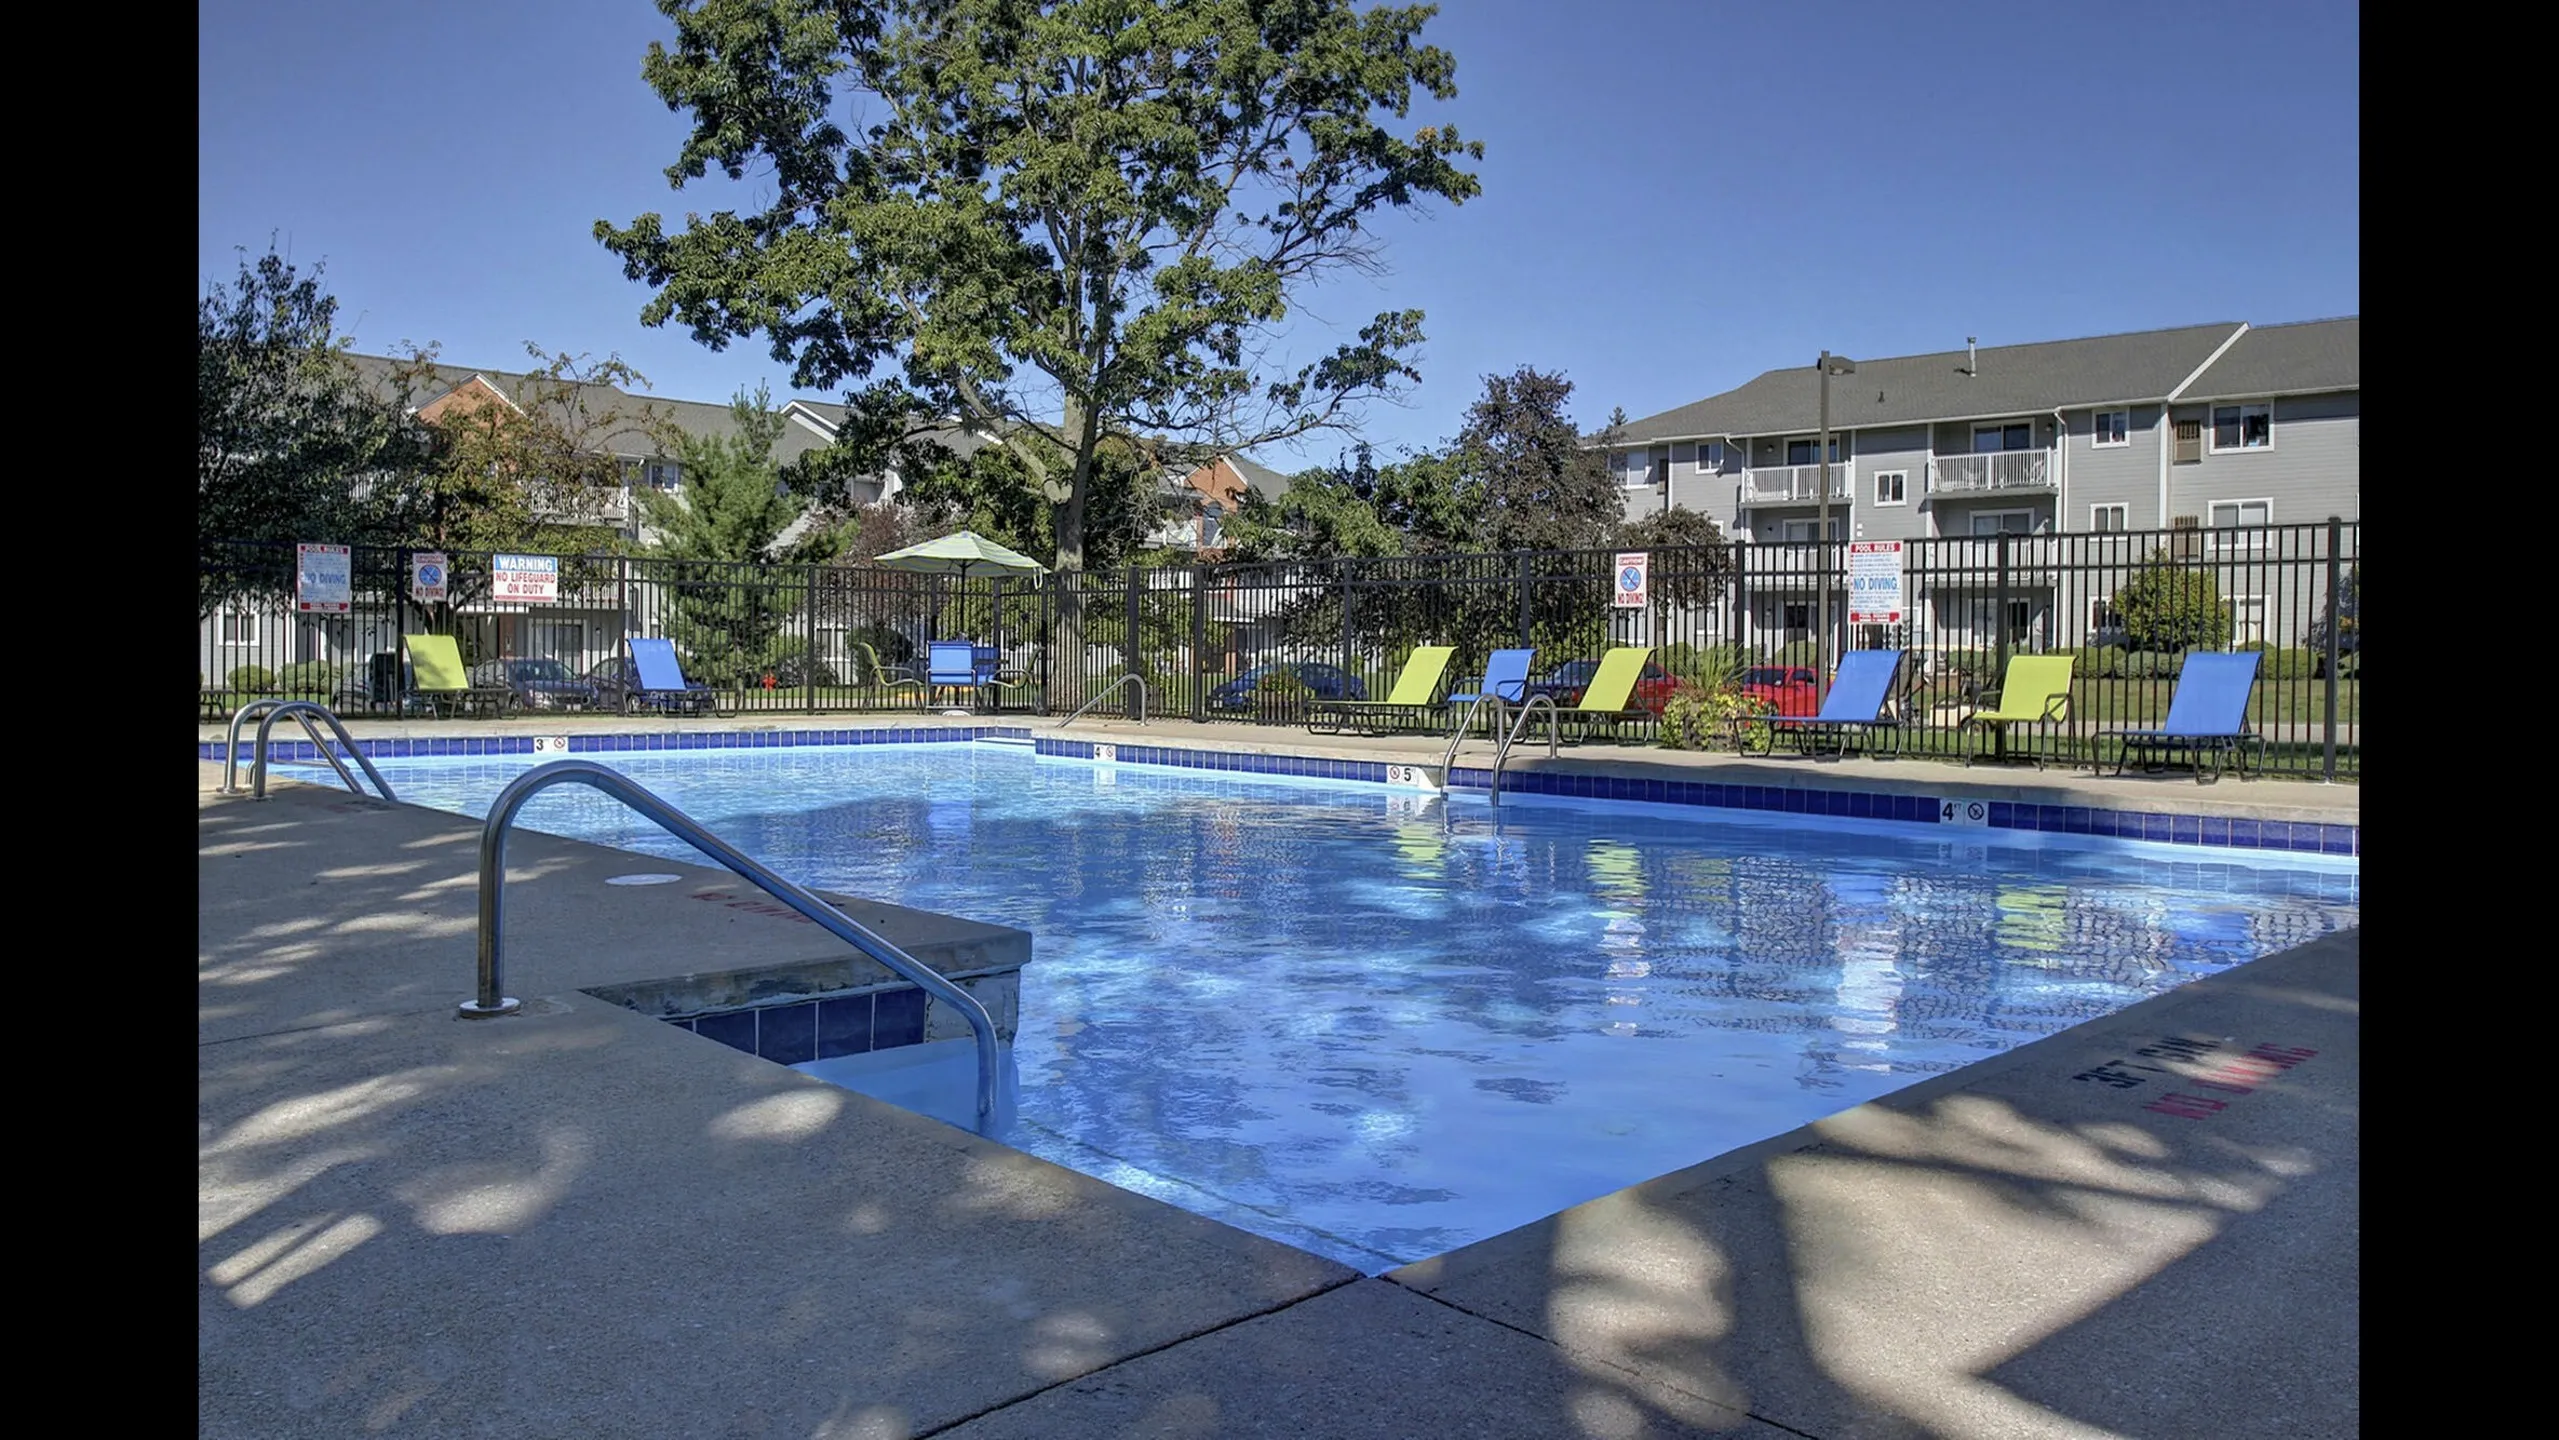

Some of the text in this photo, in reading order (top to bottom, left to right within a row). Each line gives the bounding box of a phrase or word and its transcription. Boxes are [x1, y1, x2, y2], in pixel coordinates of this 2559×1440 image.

[1855, 542, 1895, 553] POOL RULES
[498, 556, 553, 571] WARNING
[495, 571, 555, 583] NO LIFEGUARD
[507, 583, 545, 595] ON DUTY
[1854, 577, 1898, 590] NO DIVING
[415, 587, 424, 597] NO
[1618, 593, 1625, 604] NO
[2142, 1092, 2229, 1120] NO
